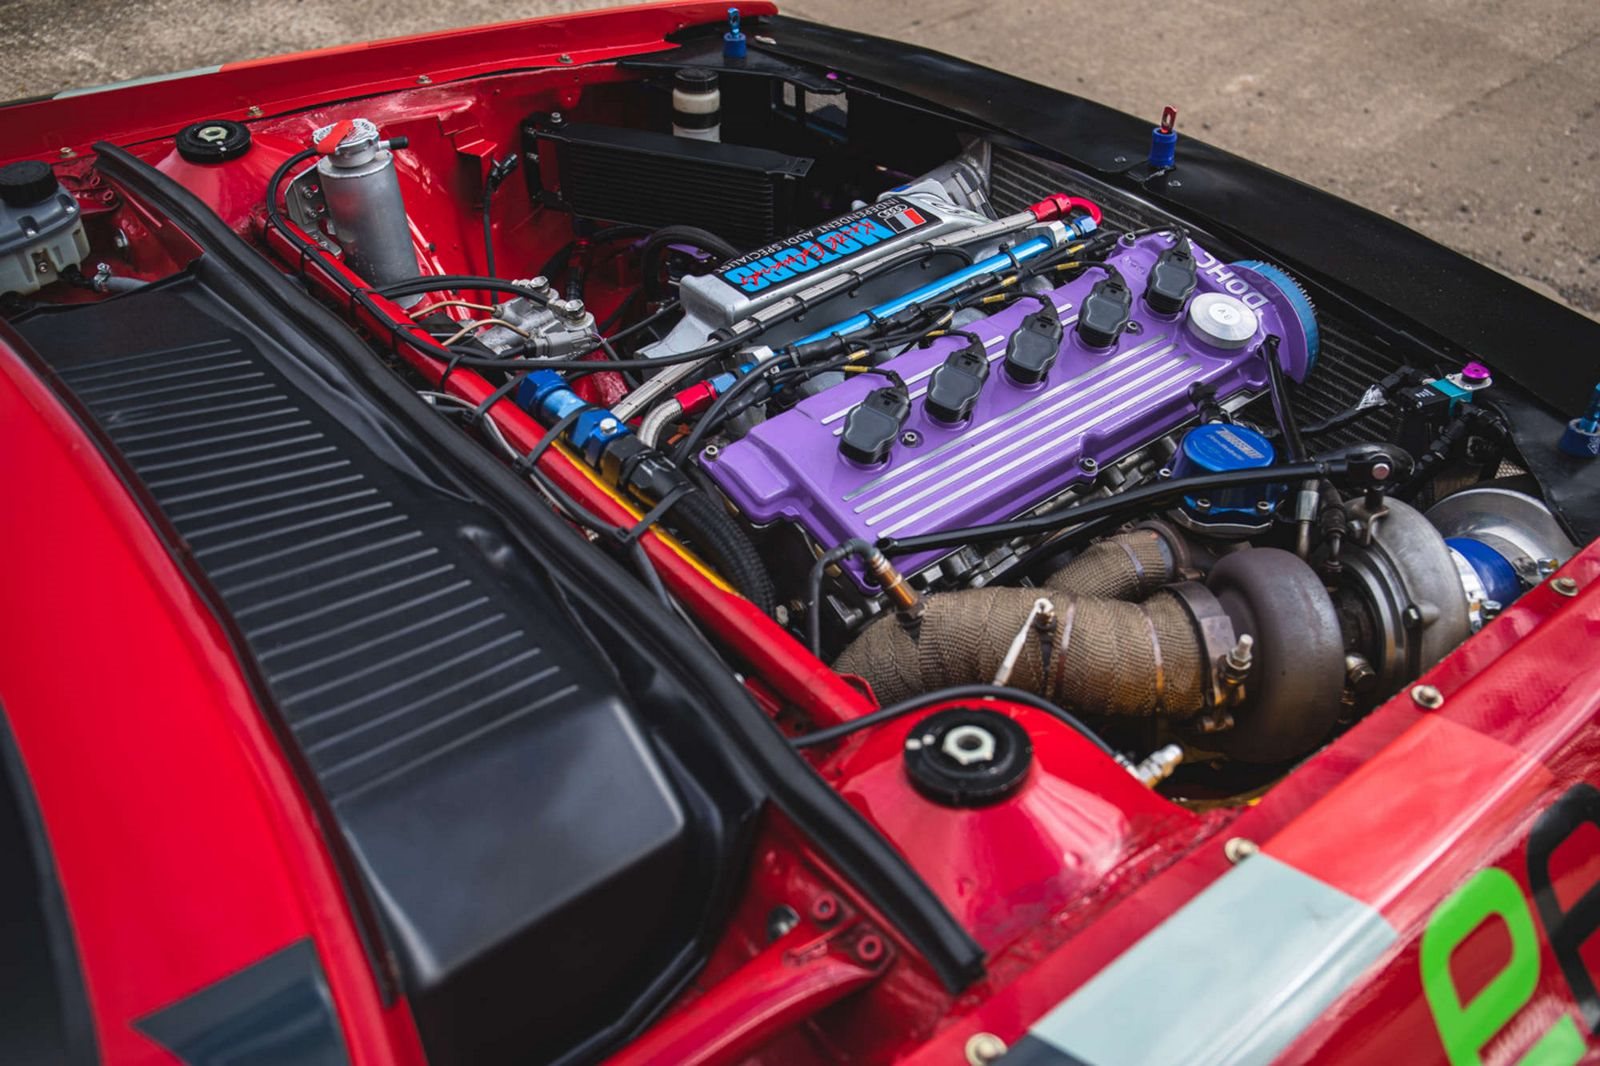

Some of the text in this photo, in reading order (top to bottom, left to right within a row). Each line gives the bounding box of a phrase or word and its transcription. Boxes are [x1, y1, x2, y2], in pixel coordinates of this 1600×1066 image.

[713, 198, 899, 273] INDEPENDENT AUDI SPECIALIST
[723, 217, 897, 292] MOTORS
[1195, 252, 1269, 309] DOHC
